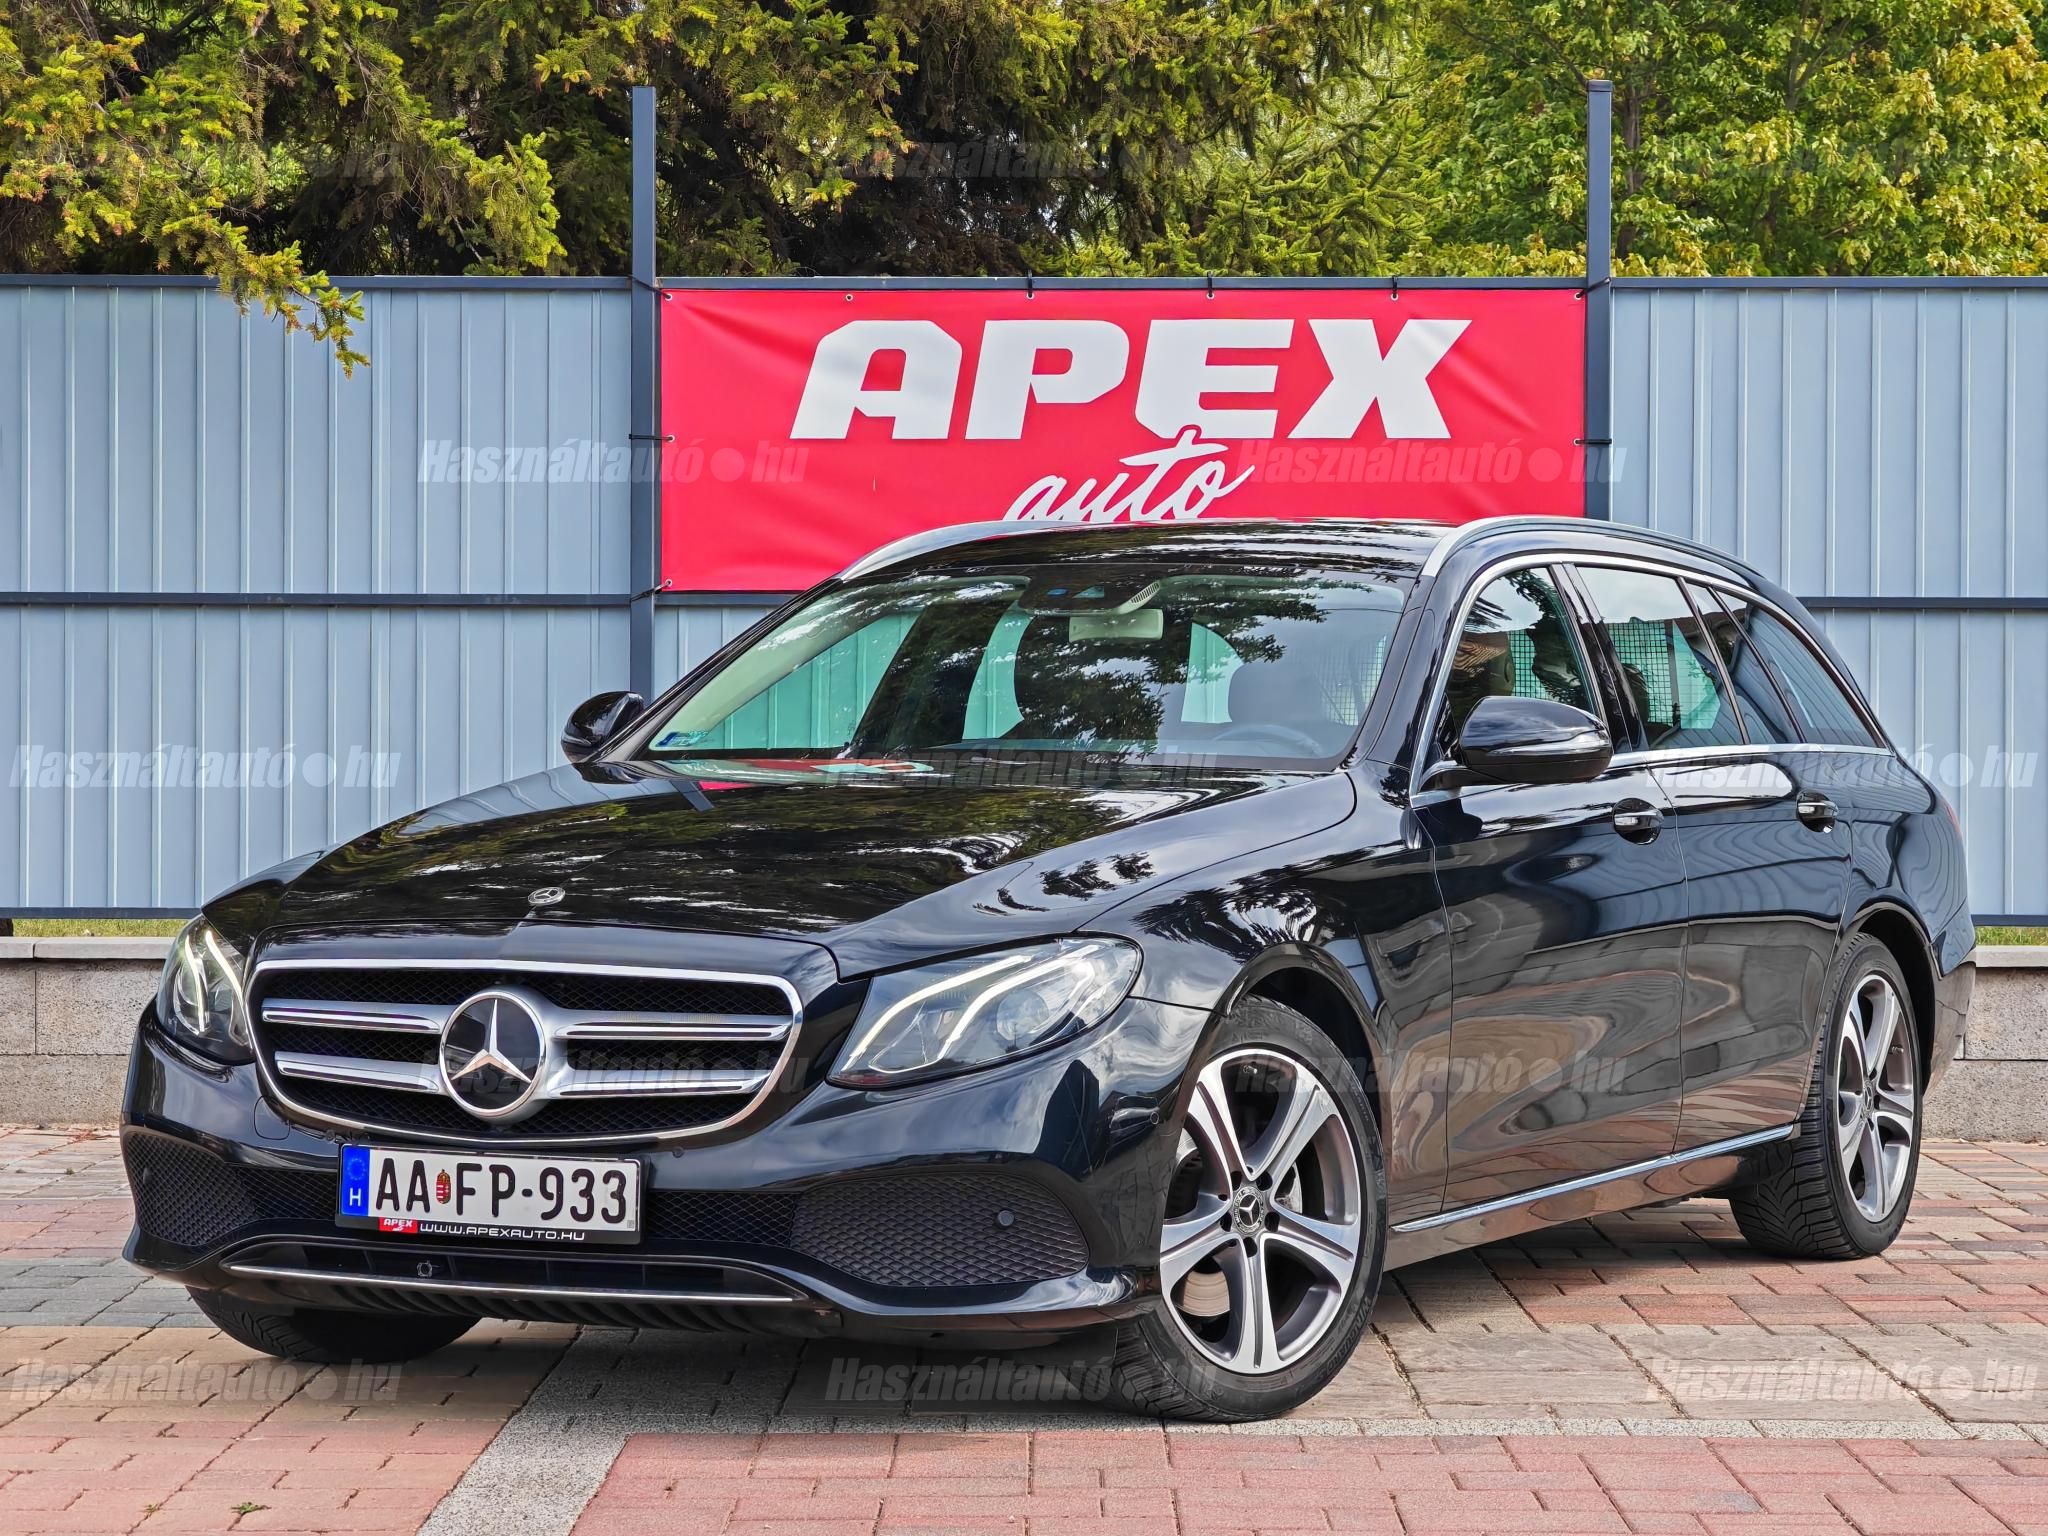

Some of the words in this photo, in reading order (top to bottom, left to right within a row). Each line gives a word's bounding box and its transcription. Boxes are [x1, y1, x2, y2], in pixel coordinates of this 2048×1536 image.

[790, 318, 1473, 441] APEX
[1002, 428, 1256, 523] auto
[349, 1188, 362, 1207] H
[383, 1218, 413, 1228] APEX
[419, 1222, 586, 1241] WWW.APEXAUTO.HU
